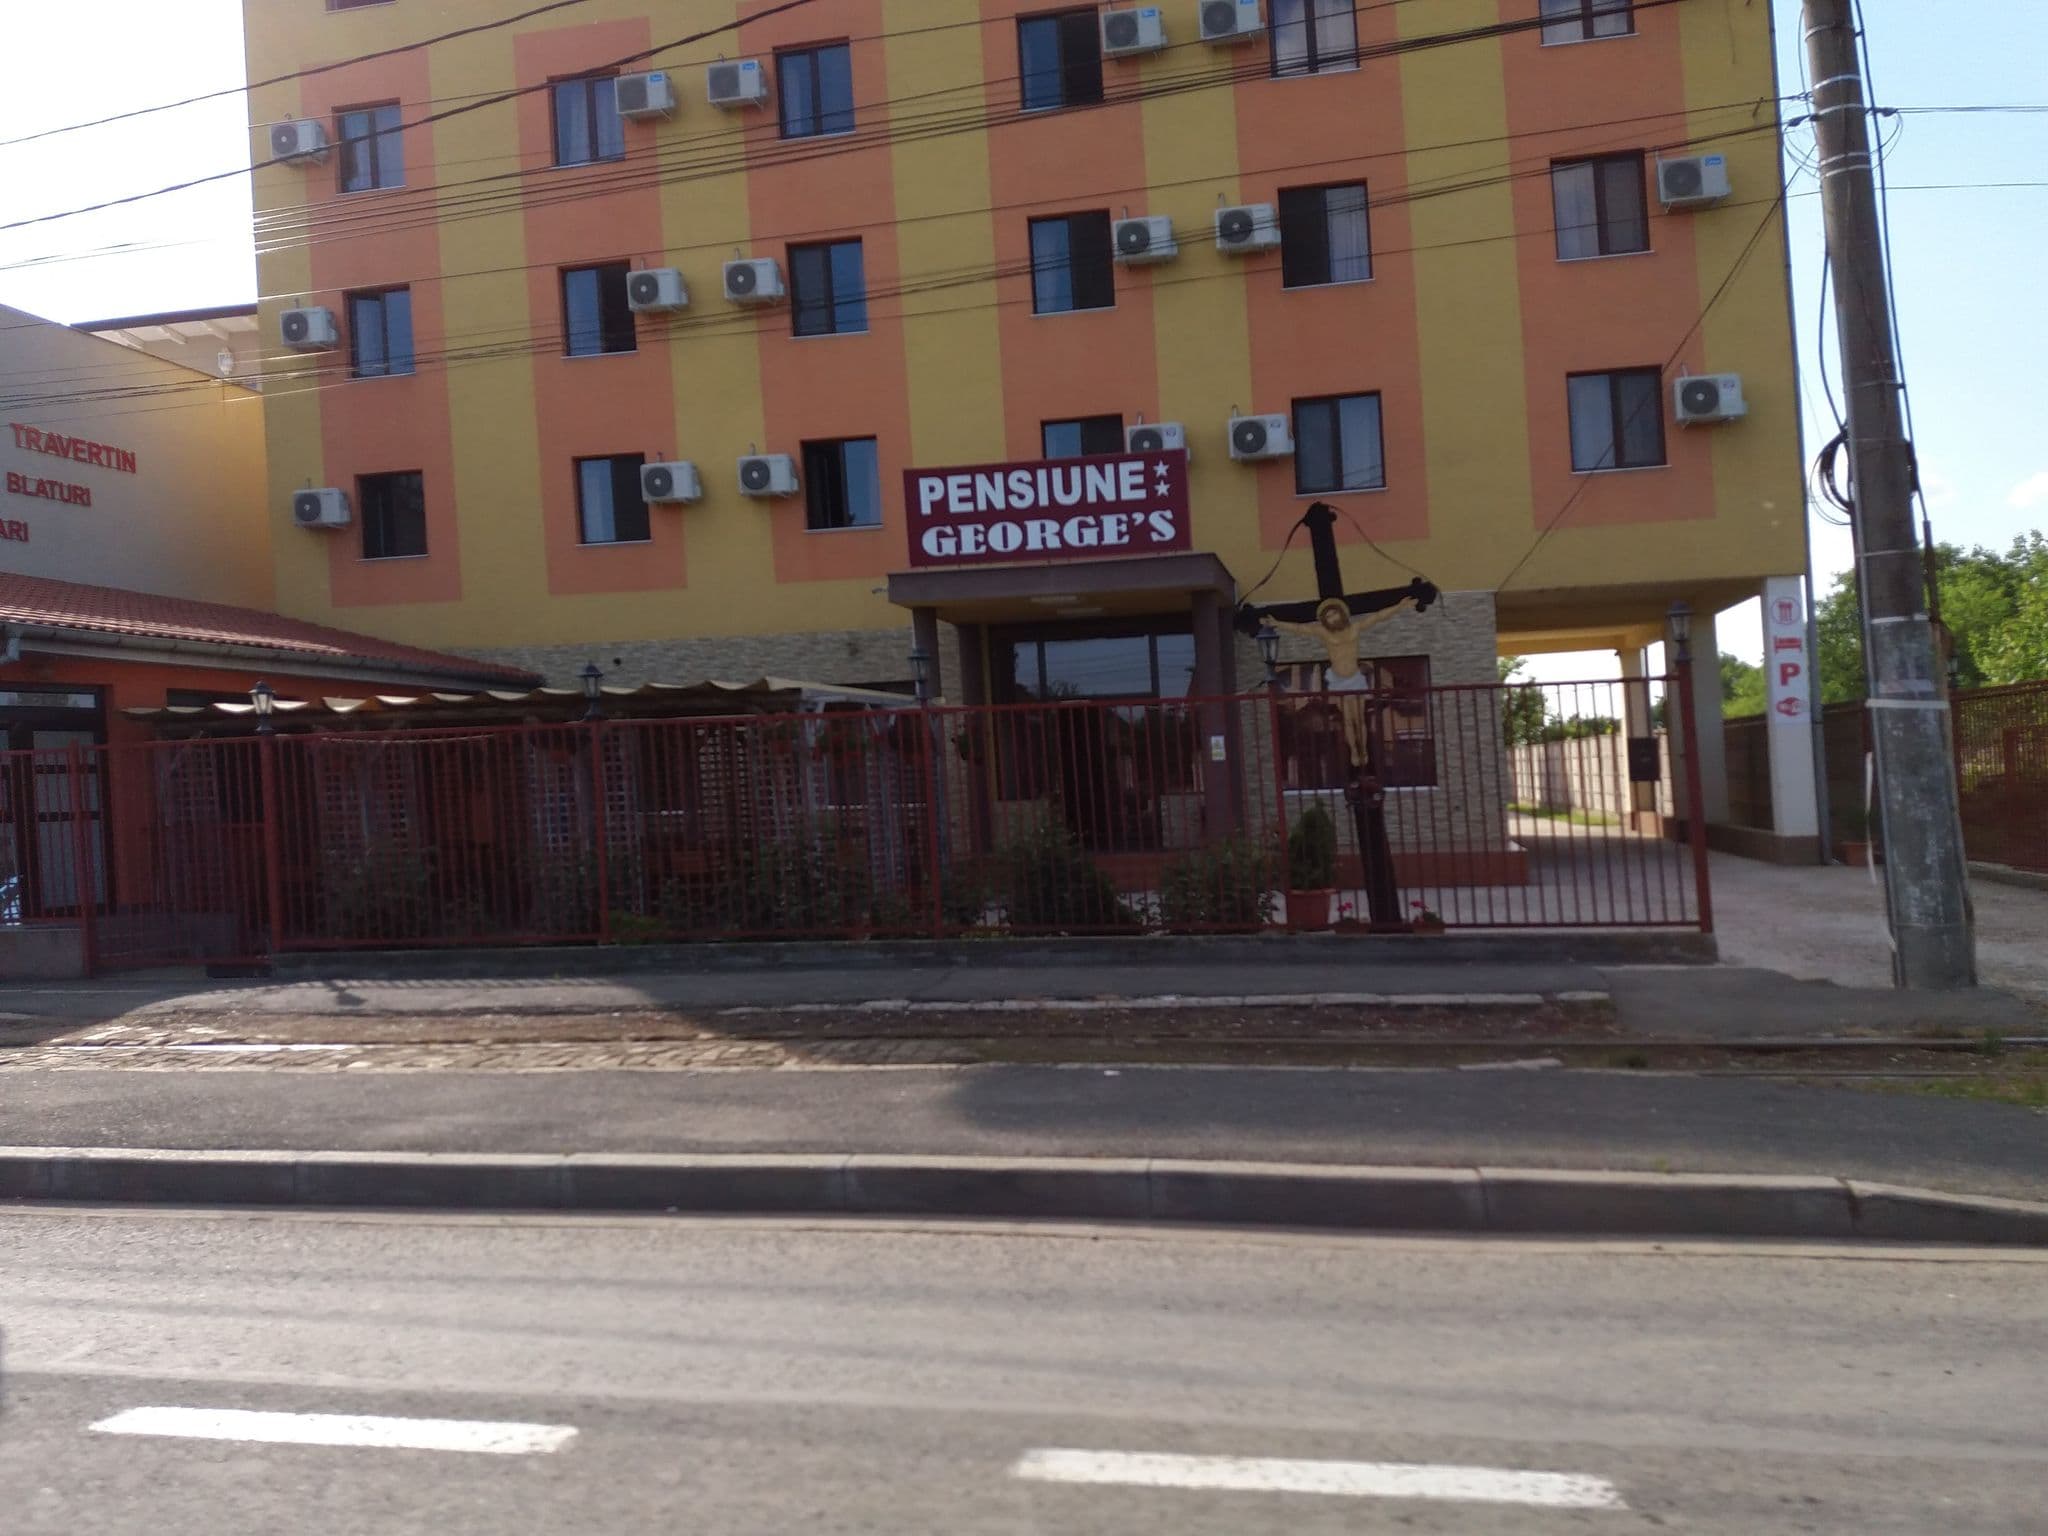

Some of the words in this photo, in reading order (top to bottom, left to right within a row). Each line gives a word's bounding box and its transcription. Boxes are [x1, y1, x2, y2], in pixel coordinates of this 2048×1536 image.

[9, 422, 136, 474] TRAVERTIN
[7, 471, 91, 507] BLATURI
[918, 460, 1147, 515] PENSIUNE
[921, 509, 1176, 557] GEORGE'S
